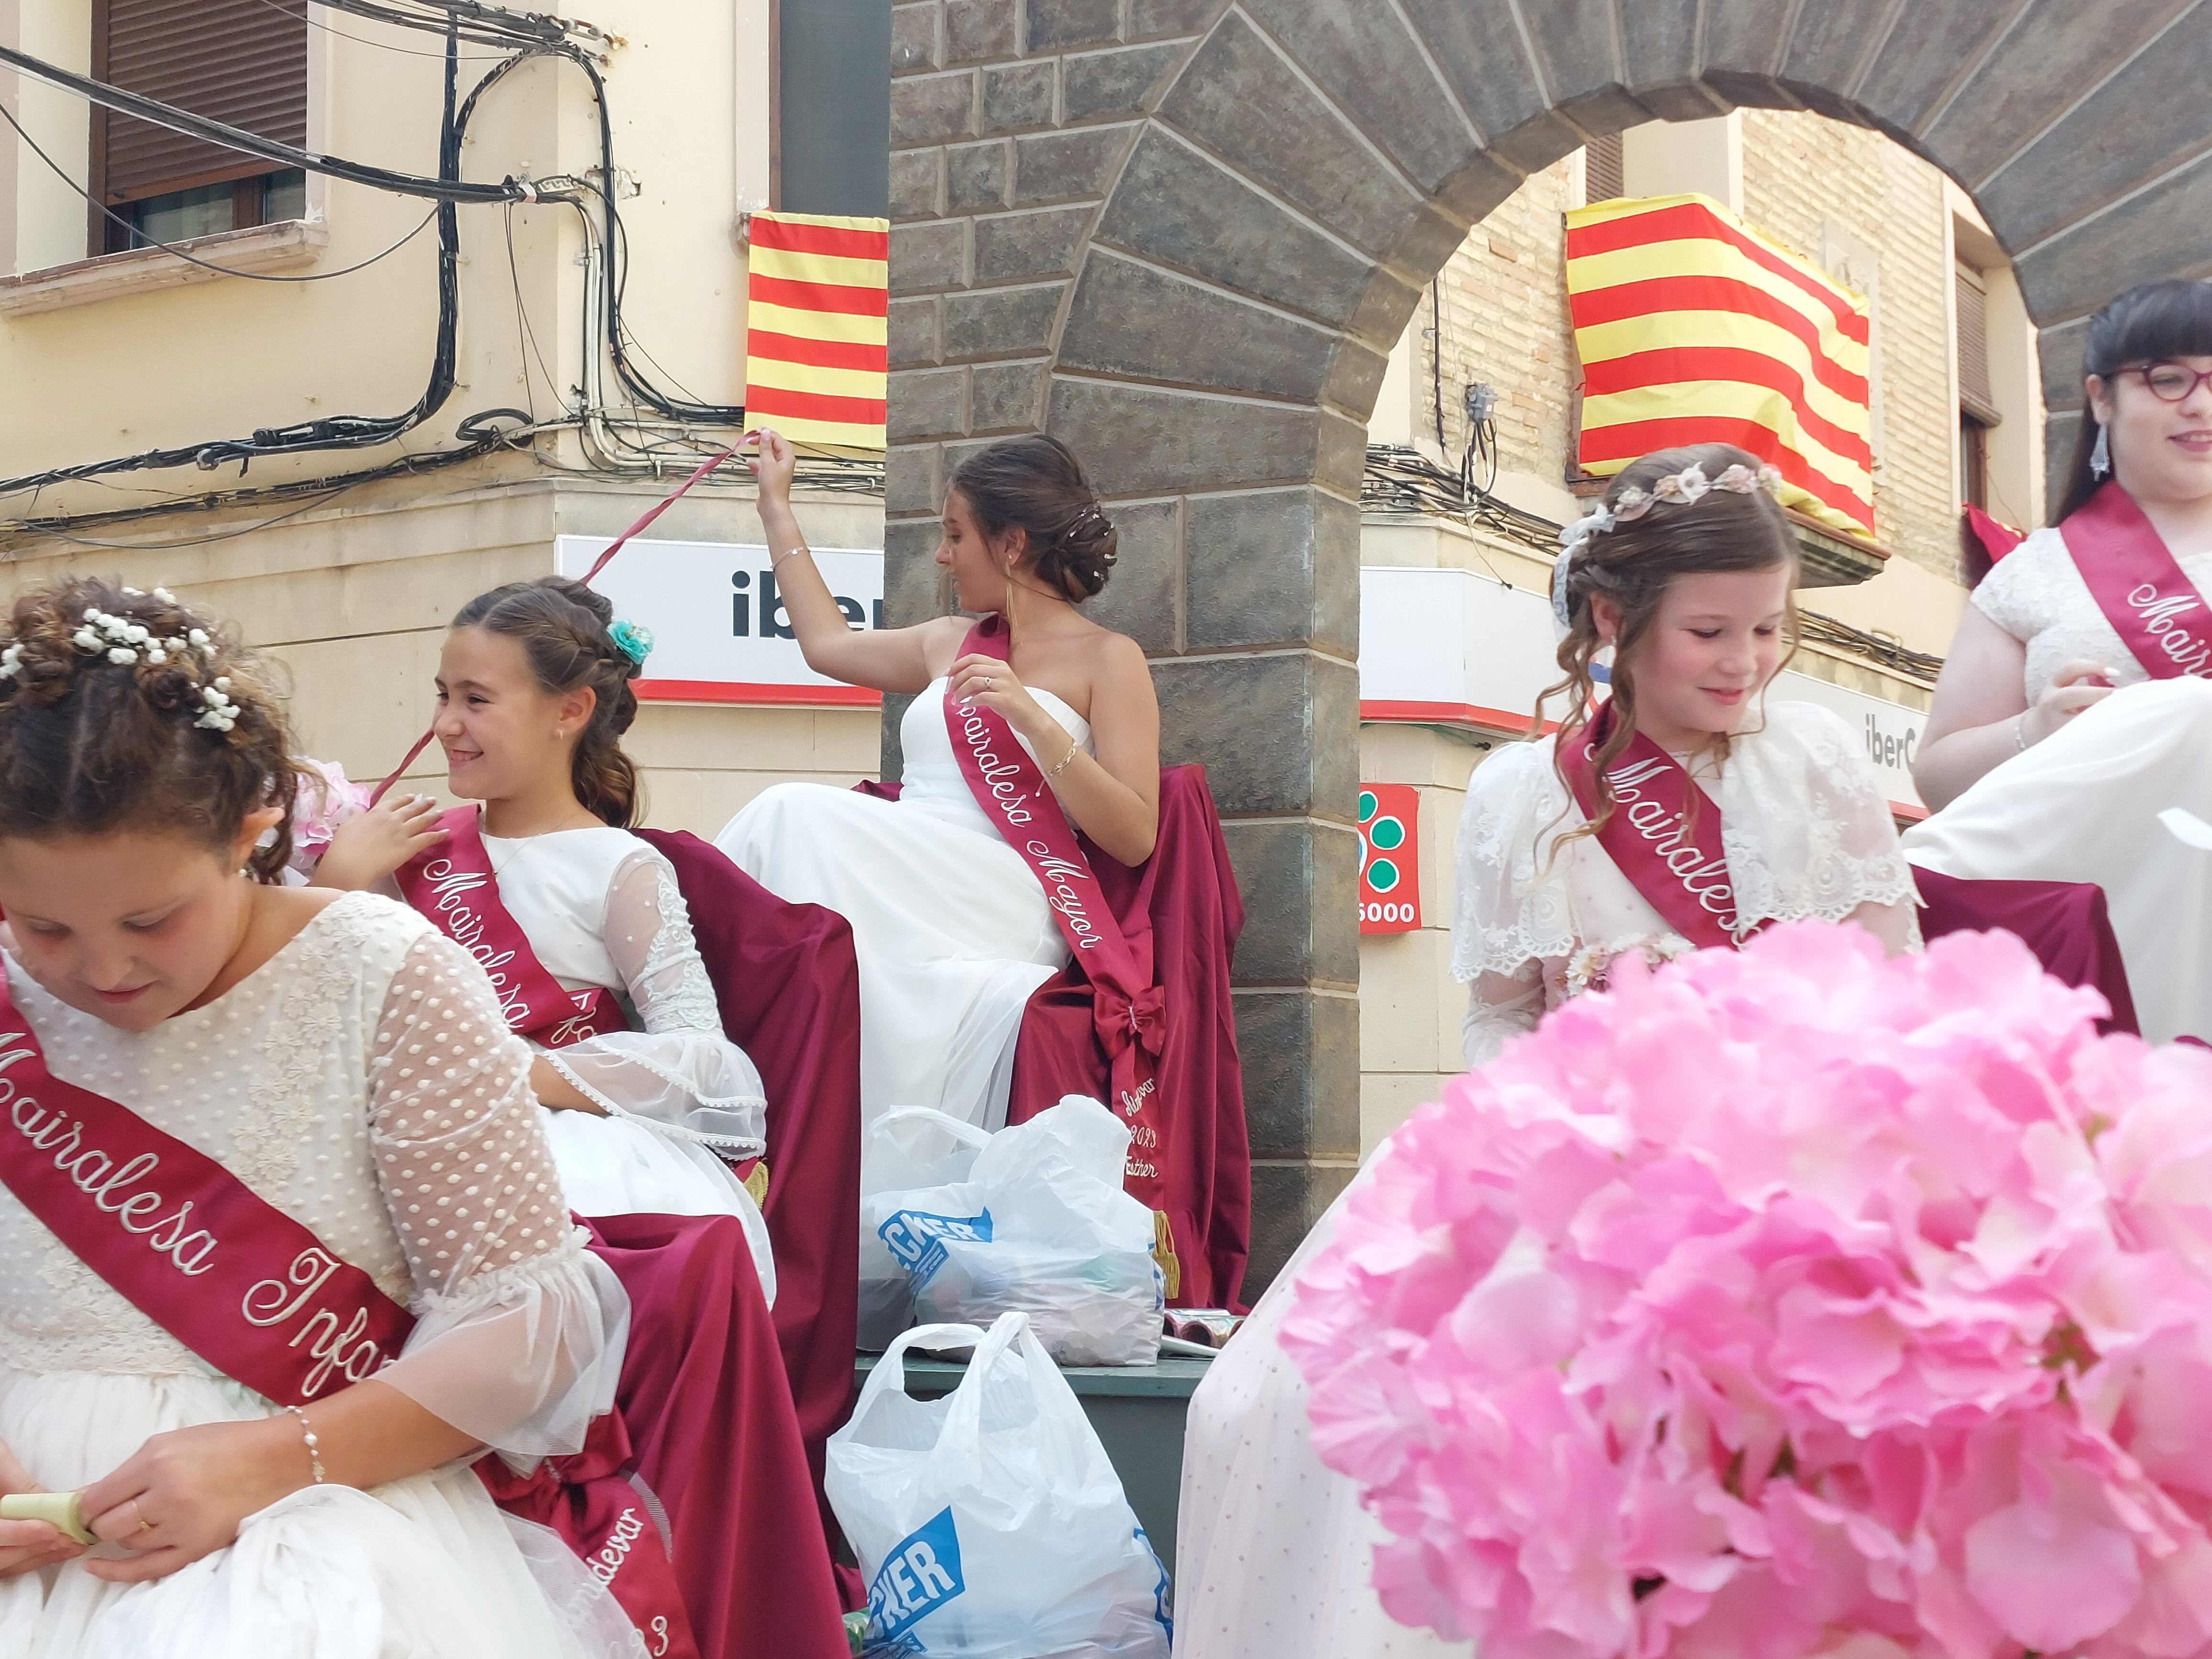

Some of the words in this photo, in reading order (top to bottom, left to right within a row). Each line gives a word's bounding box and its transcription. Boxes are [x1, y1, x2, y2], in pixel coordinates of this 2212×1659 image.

[955, 695, 1032, 828] airalesa
[1026, 840, 1103, 949] Mayor
[1131, 1124, 1156, 1148] 2023
